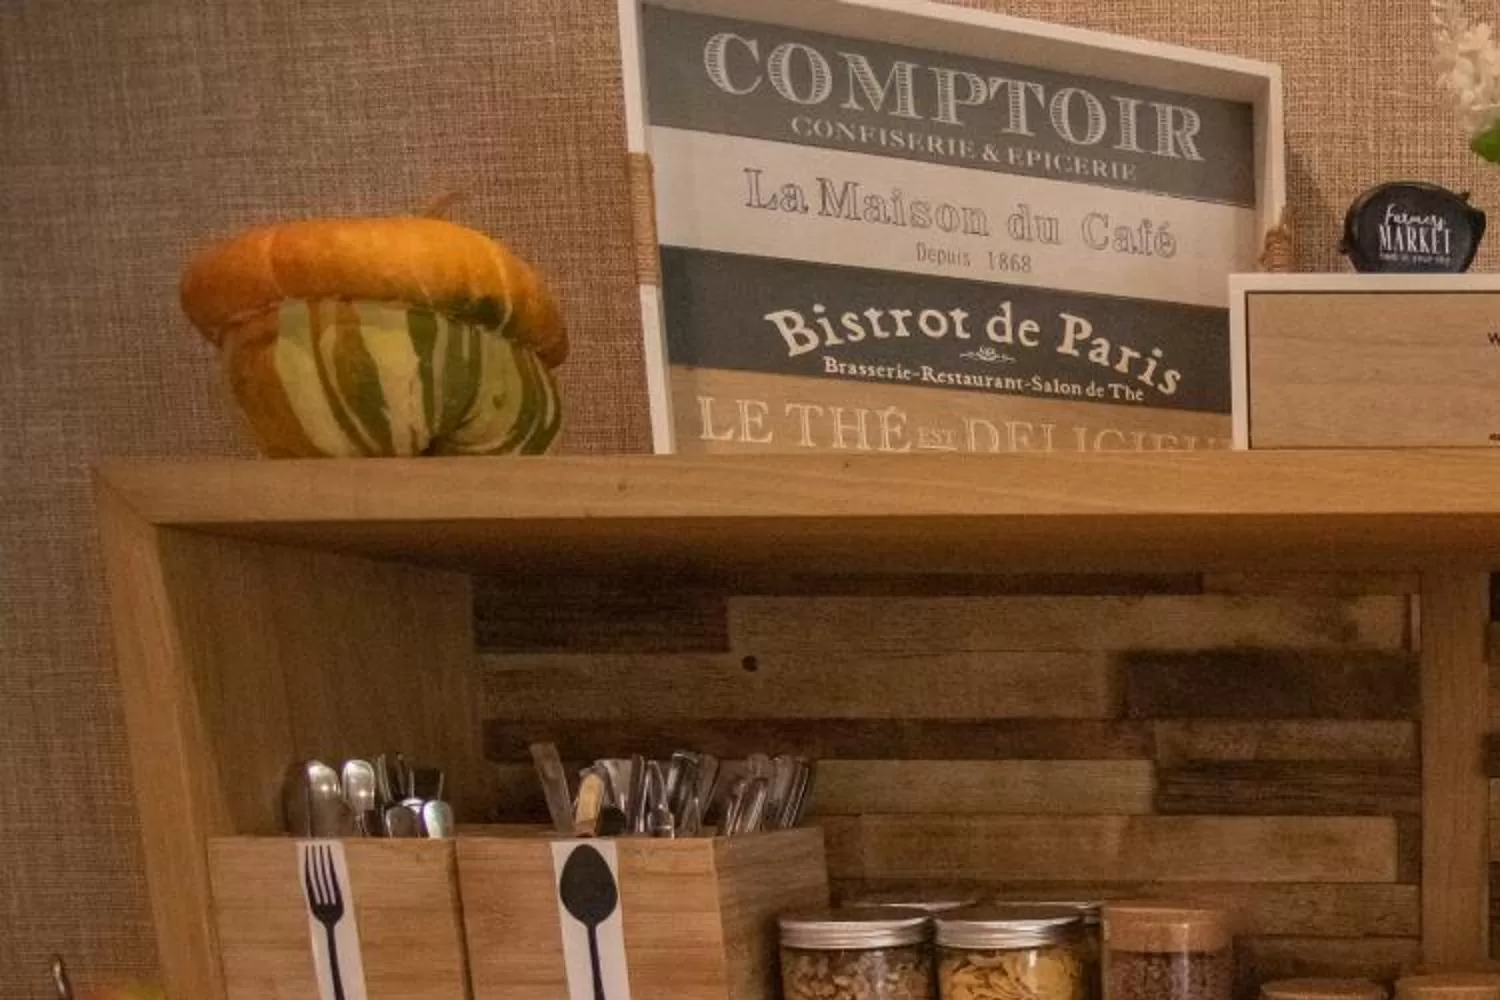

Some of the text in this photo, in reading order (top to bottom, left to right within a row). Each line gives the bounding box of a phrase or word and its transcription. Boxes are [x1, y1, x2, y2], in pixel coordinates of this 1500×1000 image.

[703, 31, 1206, 162] COMPTOIR
[791, 115, 1138, 182] CONFISERIE & EPICERIE
[743, 167, 1177, 259] La Maison du Café
[1379, 225, 1450, 254] MARKET
[917, 241, 1032, 274] Depuis 1868
[763, 301, 1182, 396] Bistrot de Paris
[1085, 380, 1105, 399] de
[696, 395, 774, 444] LE
[784, 402, 913, 453] THÉ
